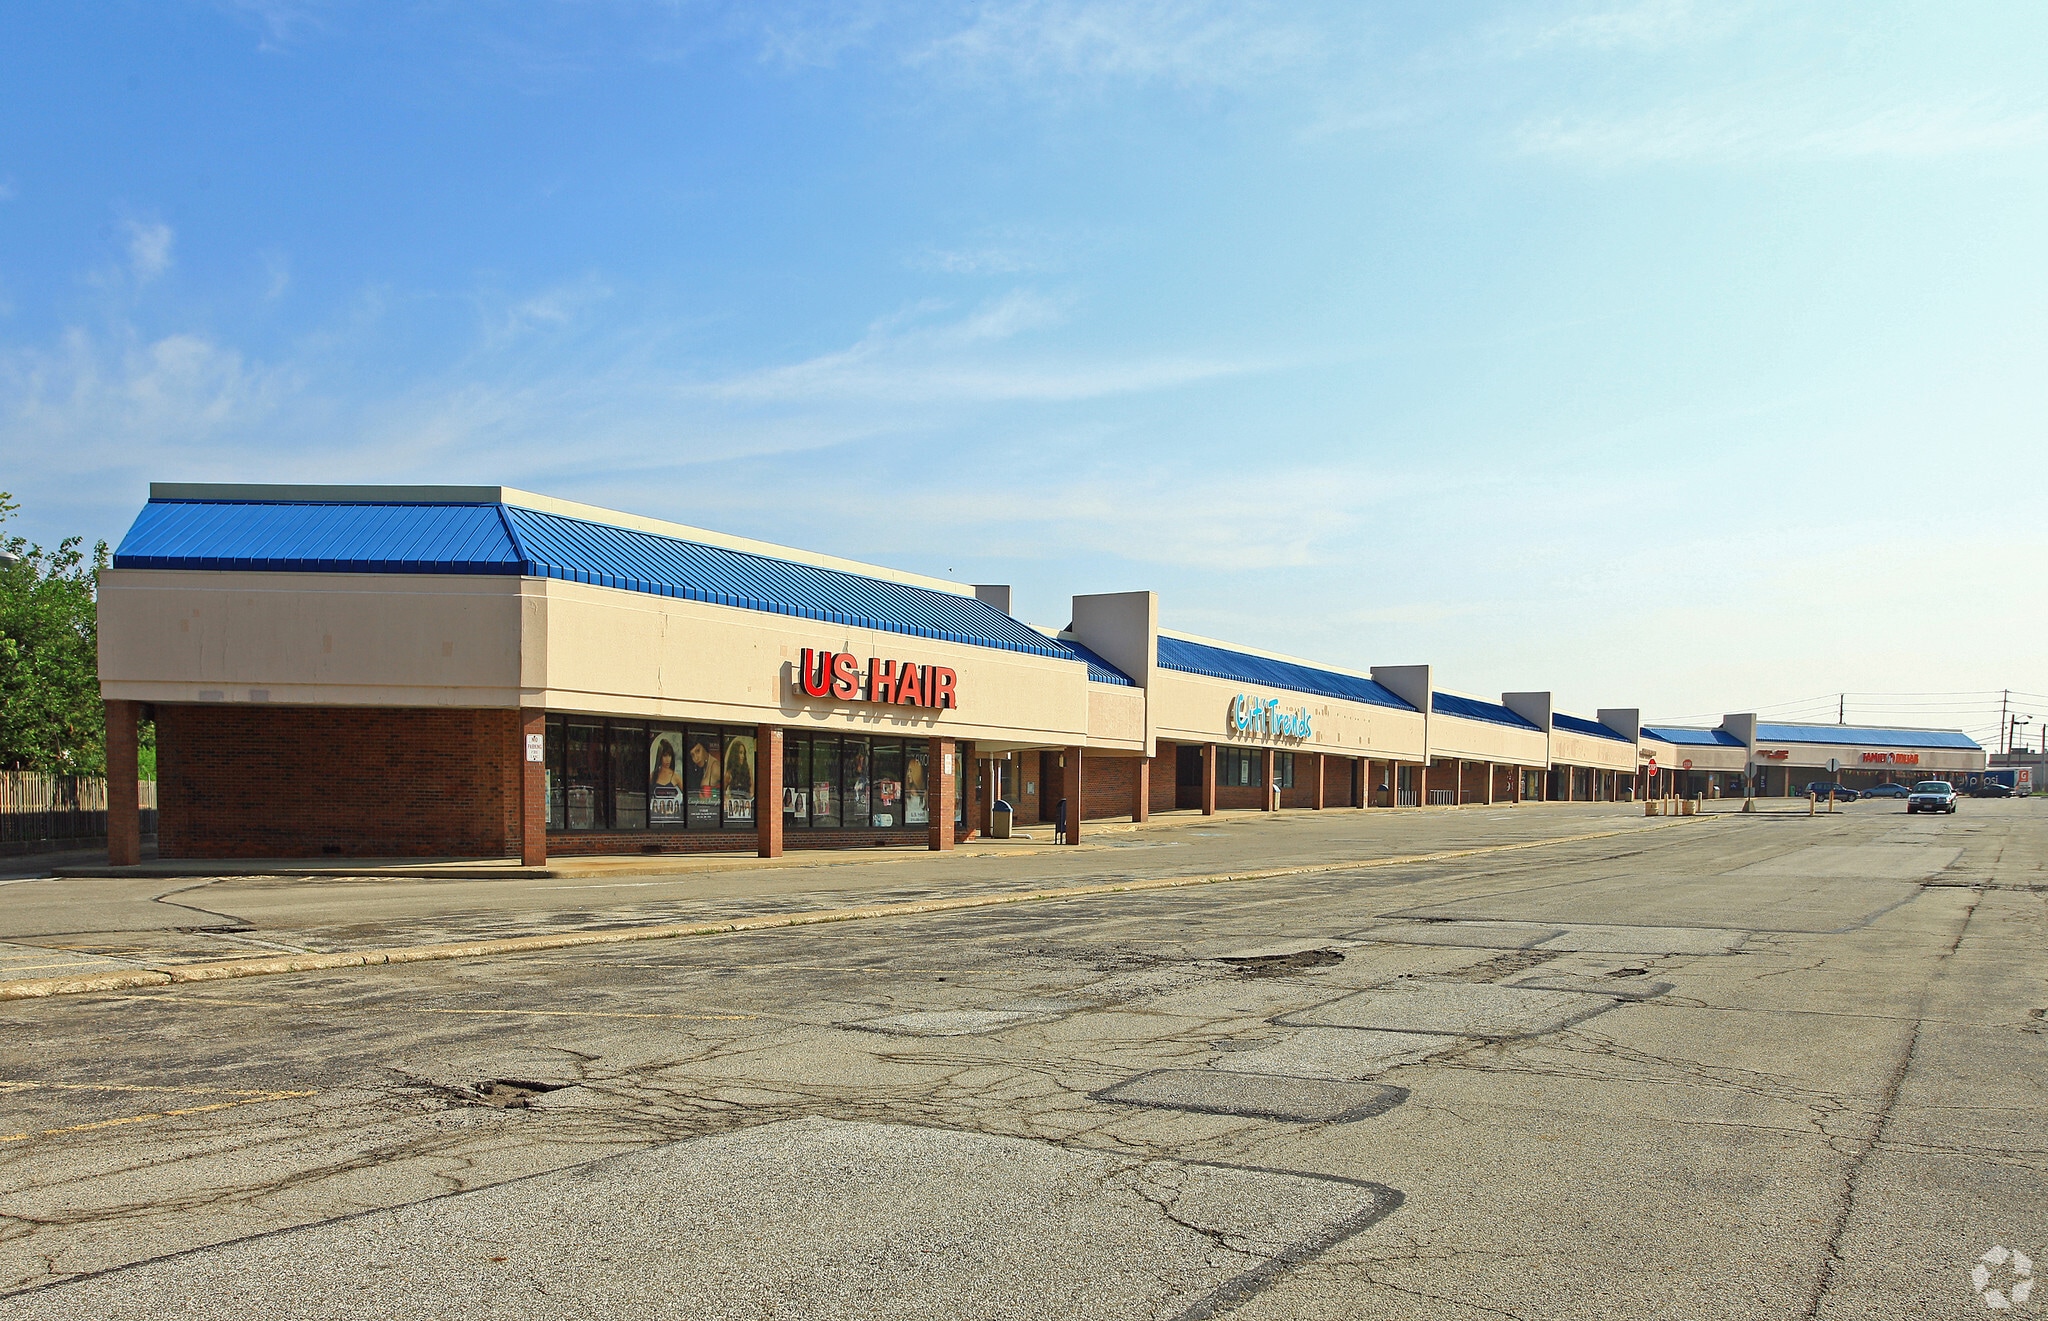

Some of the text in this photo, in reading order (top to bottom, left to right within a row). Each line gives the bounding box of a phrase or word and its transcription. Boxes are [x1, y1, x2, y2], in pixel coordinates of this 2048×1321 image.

[801, 647, 957, 709] US HAIR
[1235, 693, 1312, 737] Citi Trends
